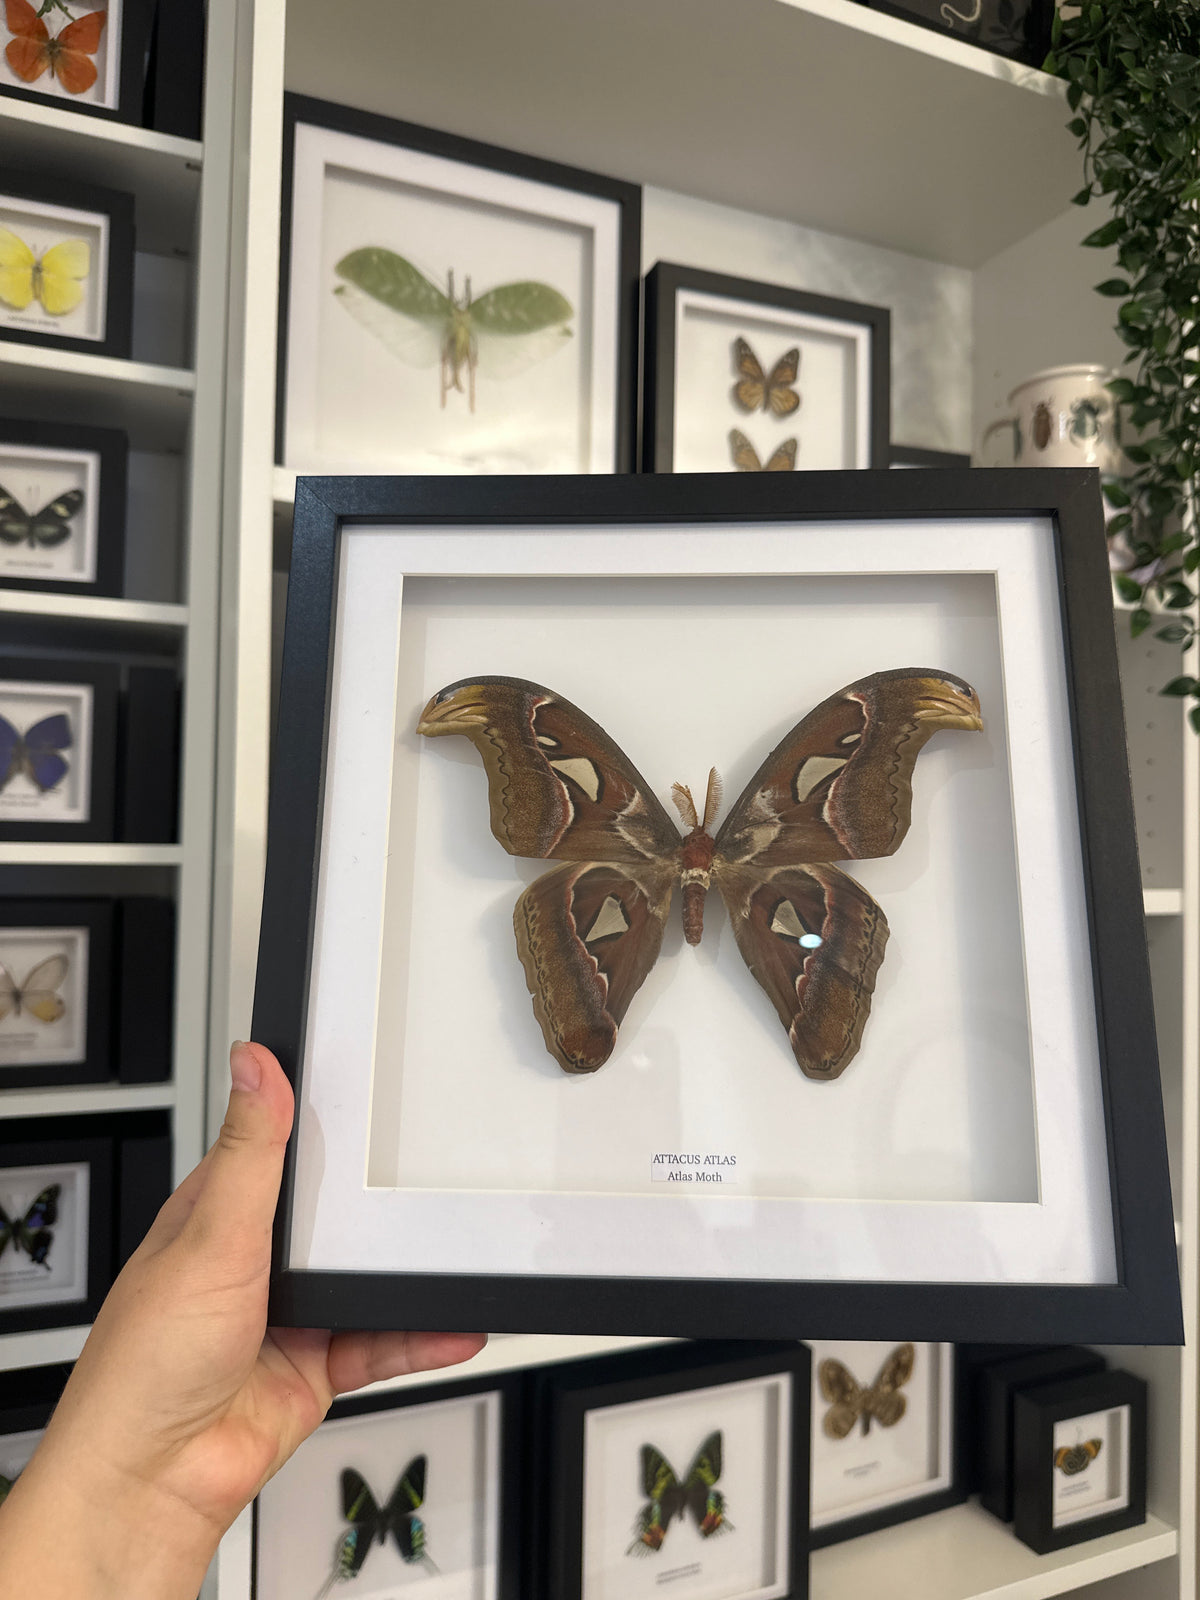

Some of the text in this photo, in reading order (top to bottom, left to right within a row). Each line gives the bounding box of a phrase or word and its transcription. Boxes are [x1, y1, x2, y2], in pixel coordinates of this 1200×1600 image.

[652, 1154, 737, 1166] ATTACUS ATLAS
[667, 1171, 722, 1182] Atlas Moth
